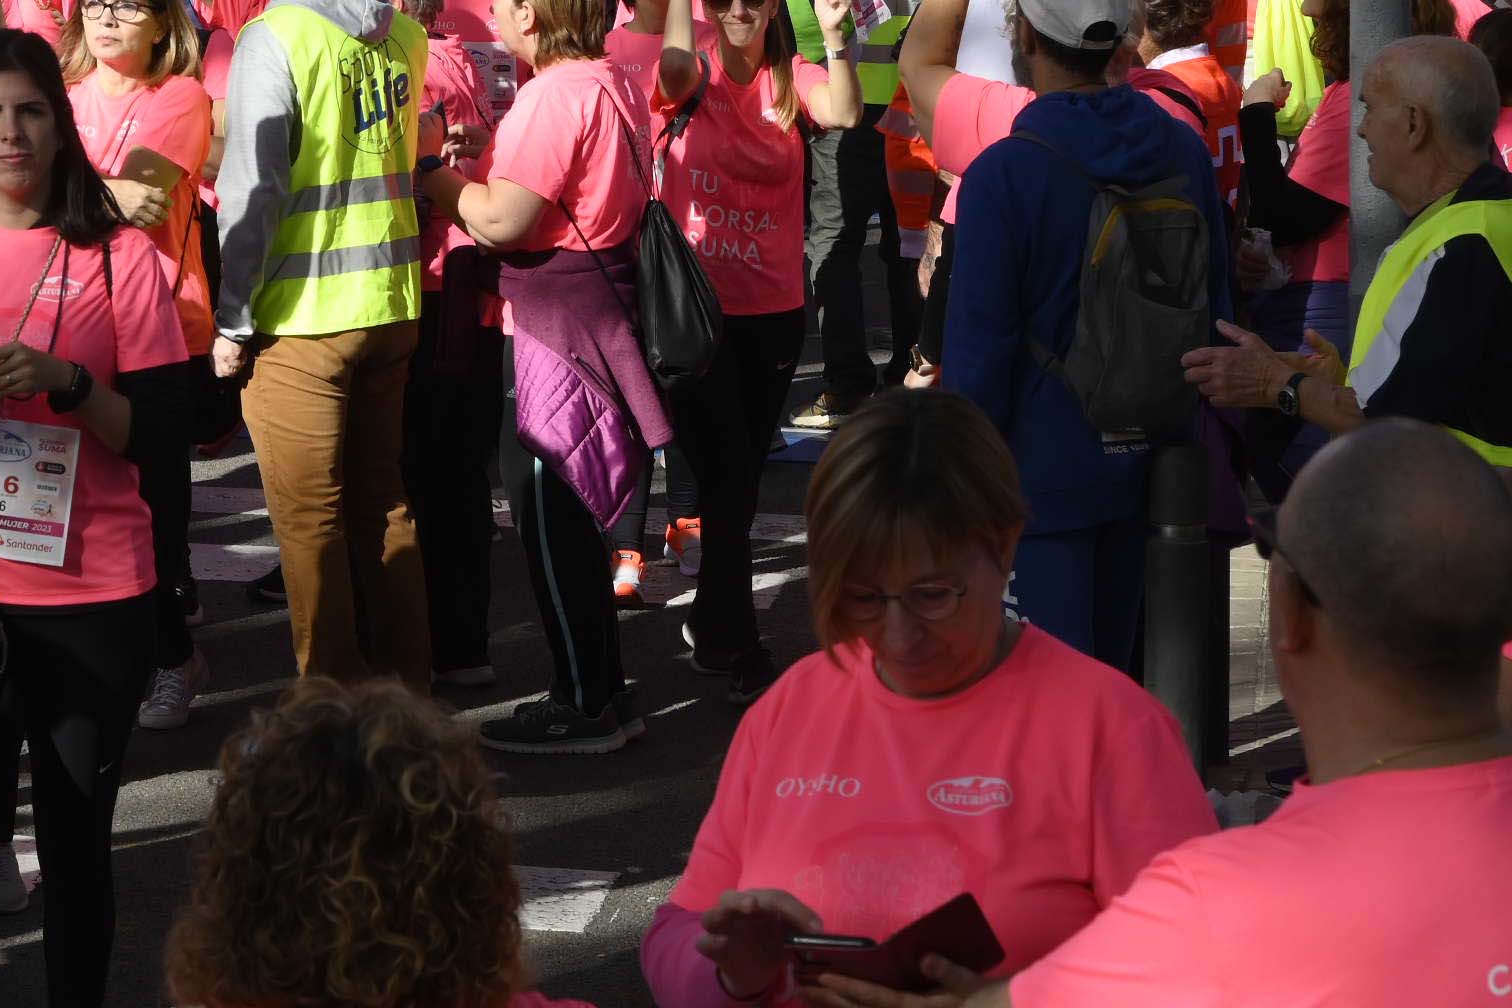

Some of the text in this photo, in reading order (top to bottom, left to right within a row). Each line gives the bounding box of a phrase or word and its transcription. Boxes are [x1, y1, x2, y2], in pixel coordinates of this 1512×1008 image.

[338, 40, 391, 92] Sport
[353, 68, 410, 134] Life
[689, 169, 717, 193] TU
[689, 200, 779, 233] DORSAL
[690, 230, 760, 263] SUMA
[0, 517, 29, 530] MUJER
[32, 522, 53, 533] 2023
[6, 537, 54, 553] Santander
[934, 785, 1008, 807] ASTURIANA
